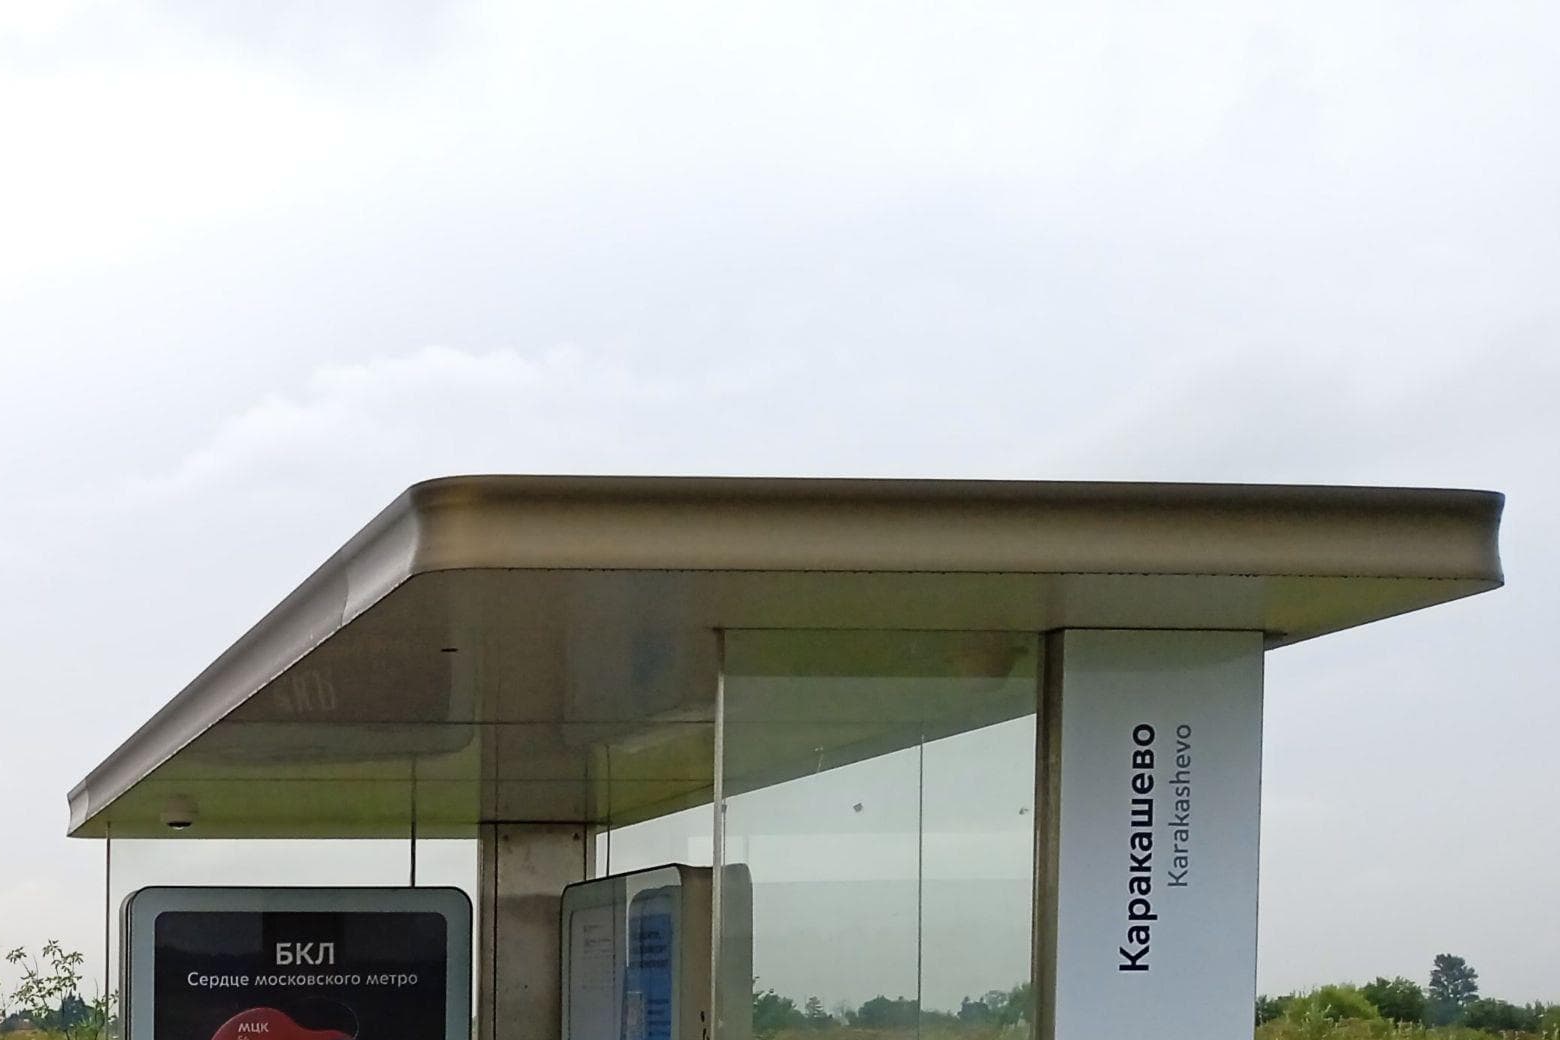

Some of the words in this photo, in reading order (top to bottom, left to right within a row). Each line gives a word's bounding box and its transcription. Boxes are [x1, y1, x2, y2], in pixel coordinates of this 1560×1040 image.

[1167, 723, 1192, 887] Karakashevo
[1118, 723, 1158, 971] Каракашево
[275, 942, 335, 965] БКЛ
[187, 971, 250, 989] Сердце
[254, 973, 361, 986] московского
[366, 973, 418, 987] метро
[238, 1022, 270, 1034] МЦК
